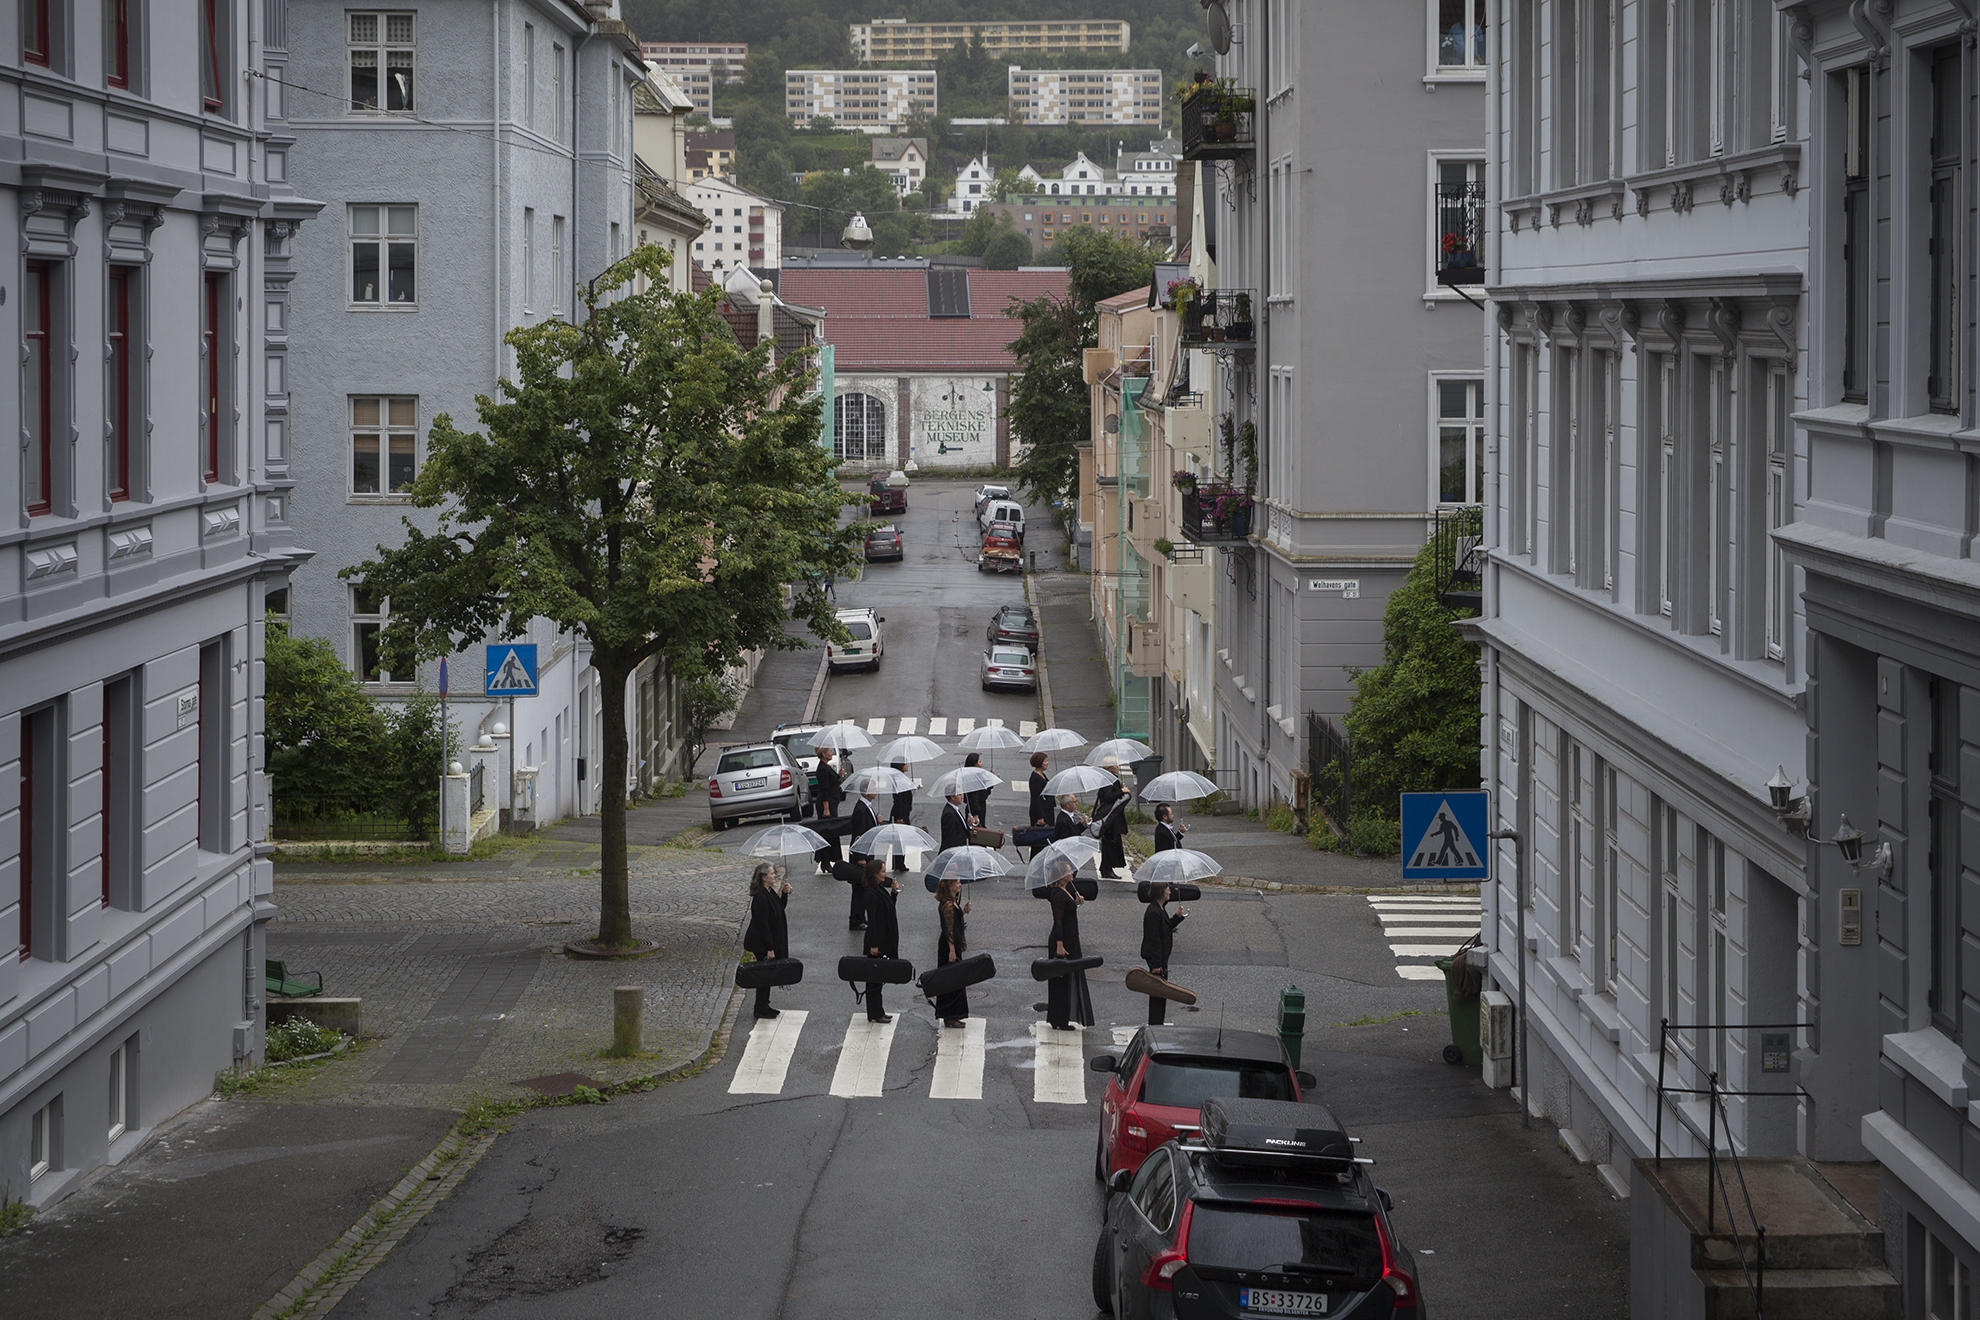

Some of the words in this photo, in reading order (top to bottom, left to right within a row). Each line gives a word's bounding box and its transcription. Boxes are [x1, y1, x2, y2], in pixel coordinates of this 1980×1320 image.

[923, 409, 985, 420] BERGENS
[920, 421, 986, 431] TEKNISKE
[926, 431, 980, 443] MUSEUM
[1344, 581, 1356, 590] gate
[1847, 896, 1853, 906] 1
[1265, 1138, 1307, 1147] PACKLINE
[1237, 1272, 1334, 1286] VOLVO
[1252, 1291, 1269, 1306] BS
[1277, 1293, 1323, 1310] 33726
